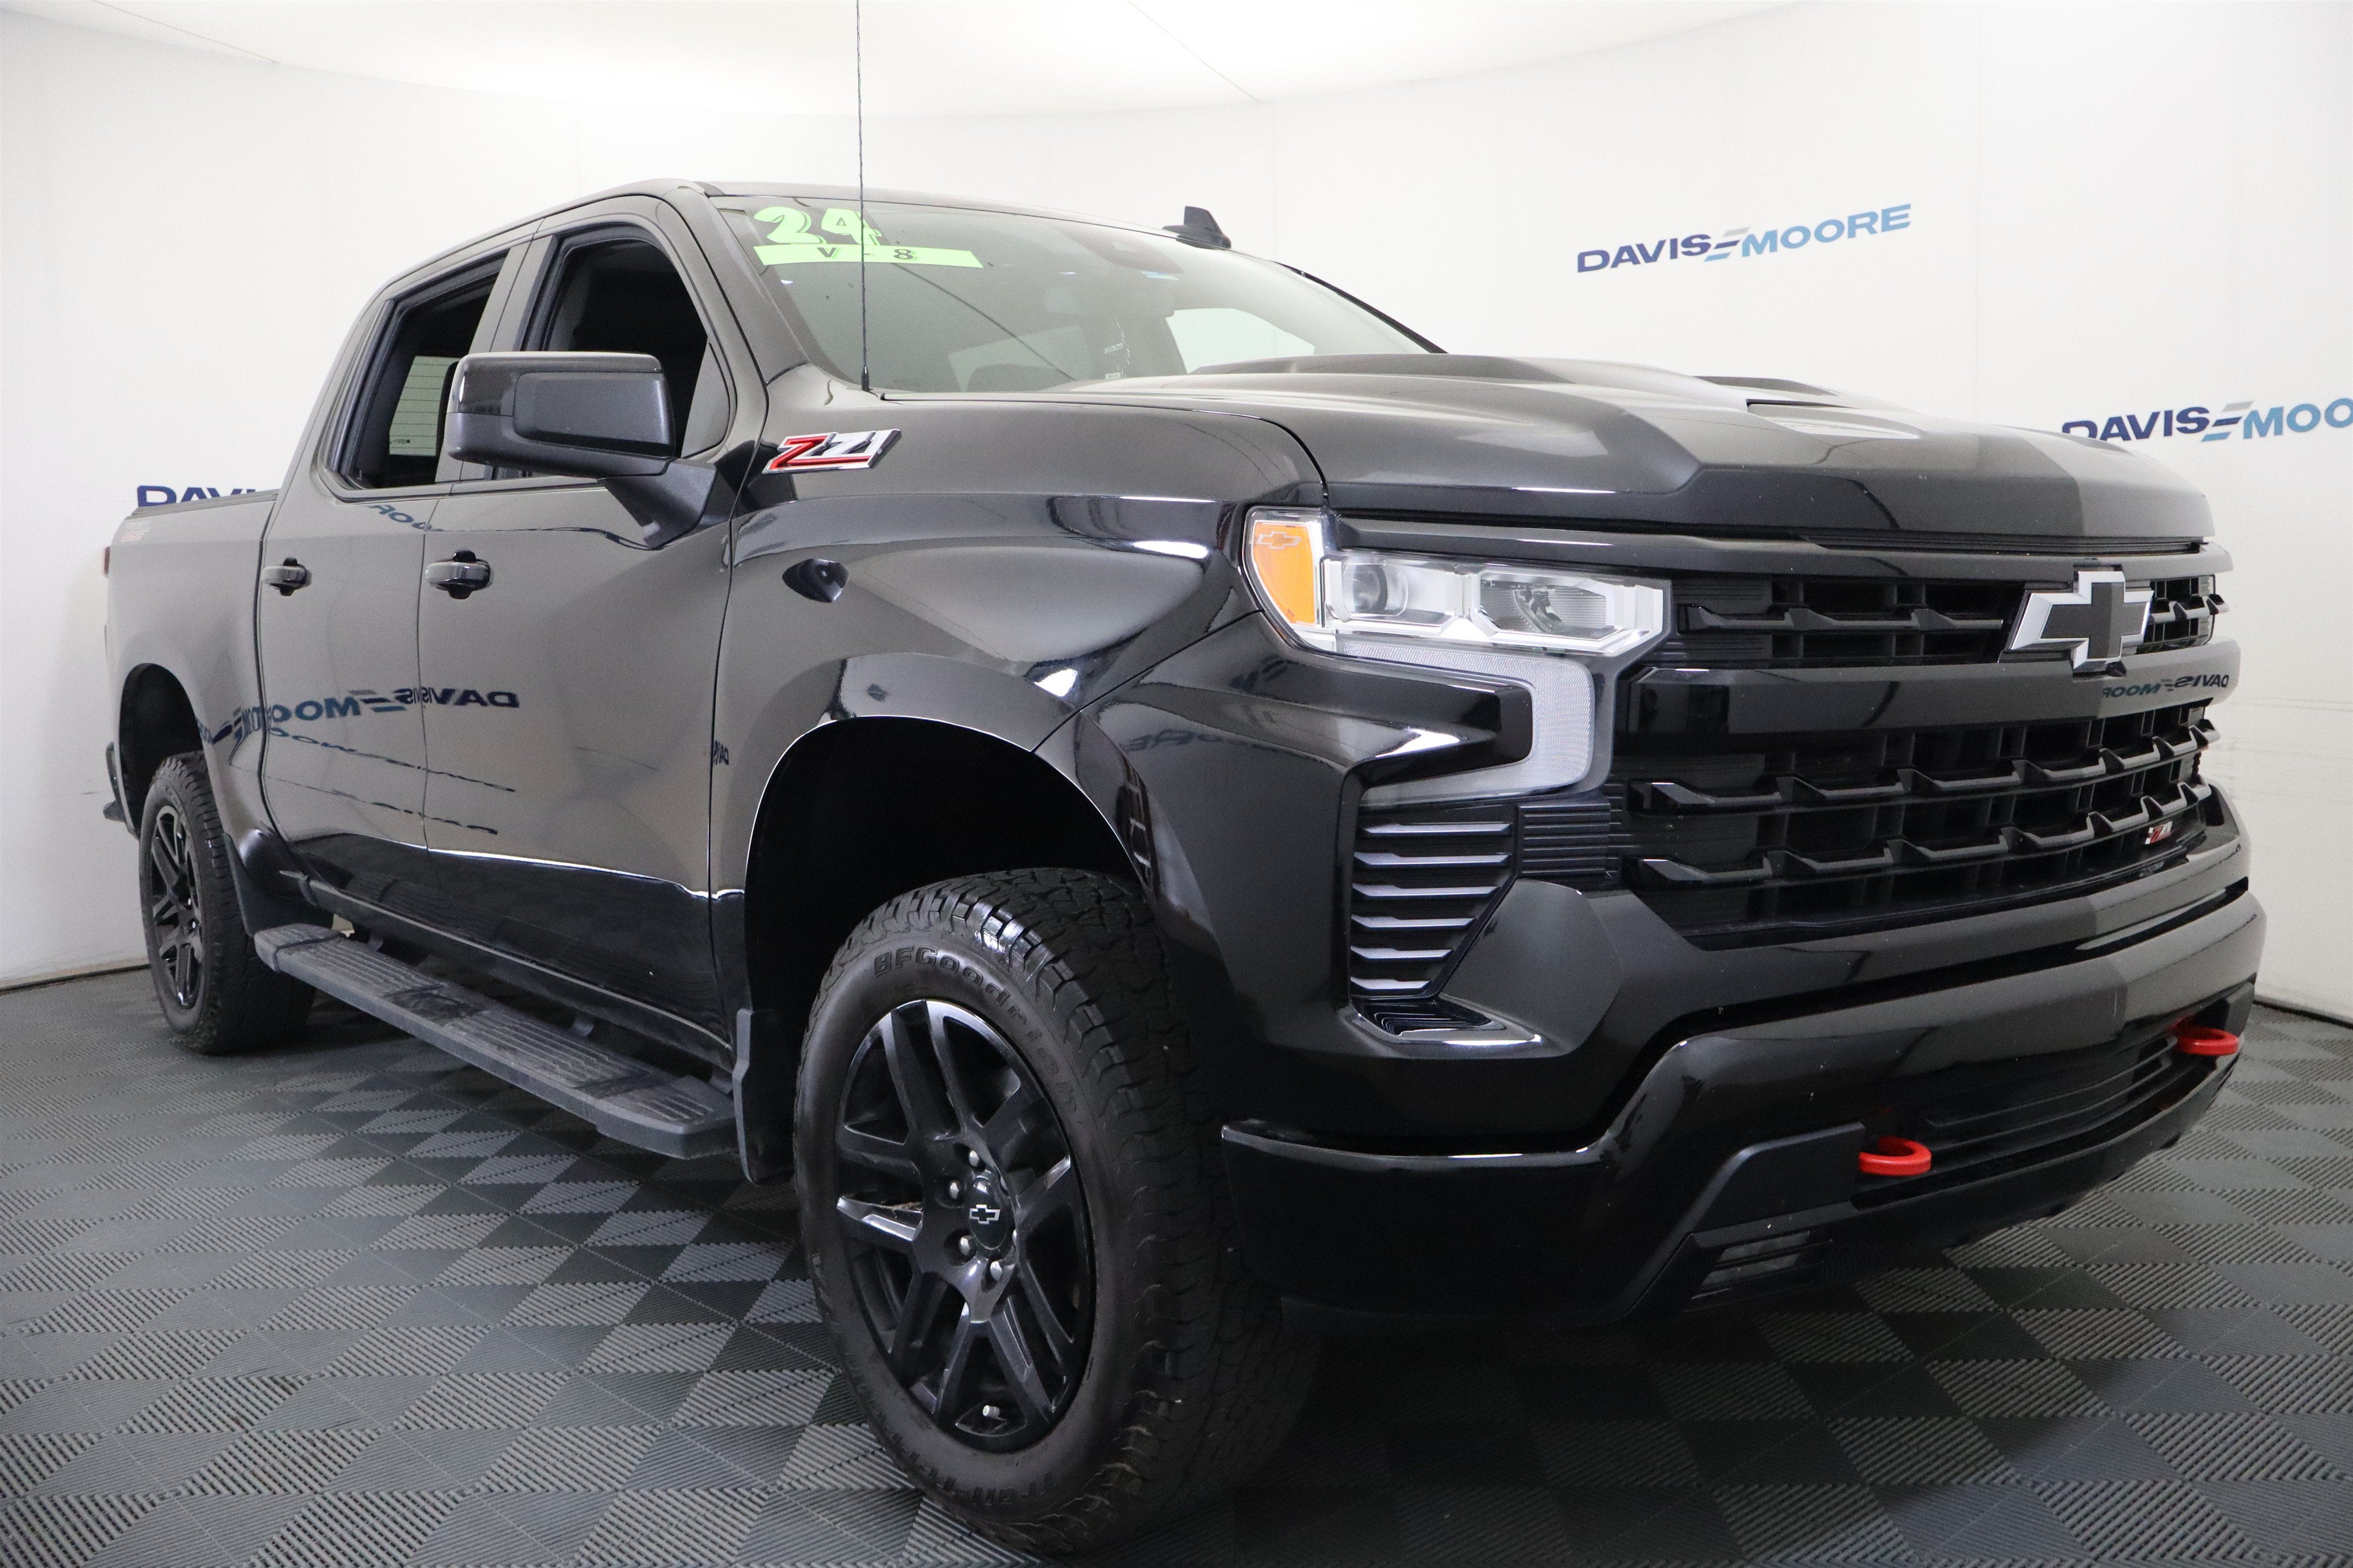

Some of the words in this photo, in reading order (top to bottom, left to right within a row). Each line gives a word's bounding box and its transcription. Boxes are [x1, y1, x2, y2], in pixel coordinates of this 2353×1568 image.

[754, 206, 882, 245] 24
[1577, 233, 1712, 273] DAVIS
[1742, 203, 1911, 258] MOORE
[762, 428, 901, 474] Z71
